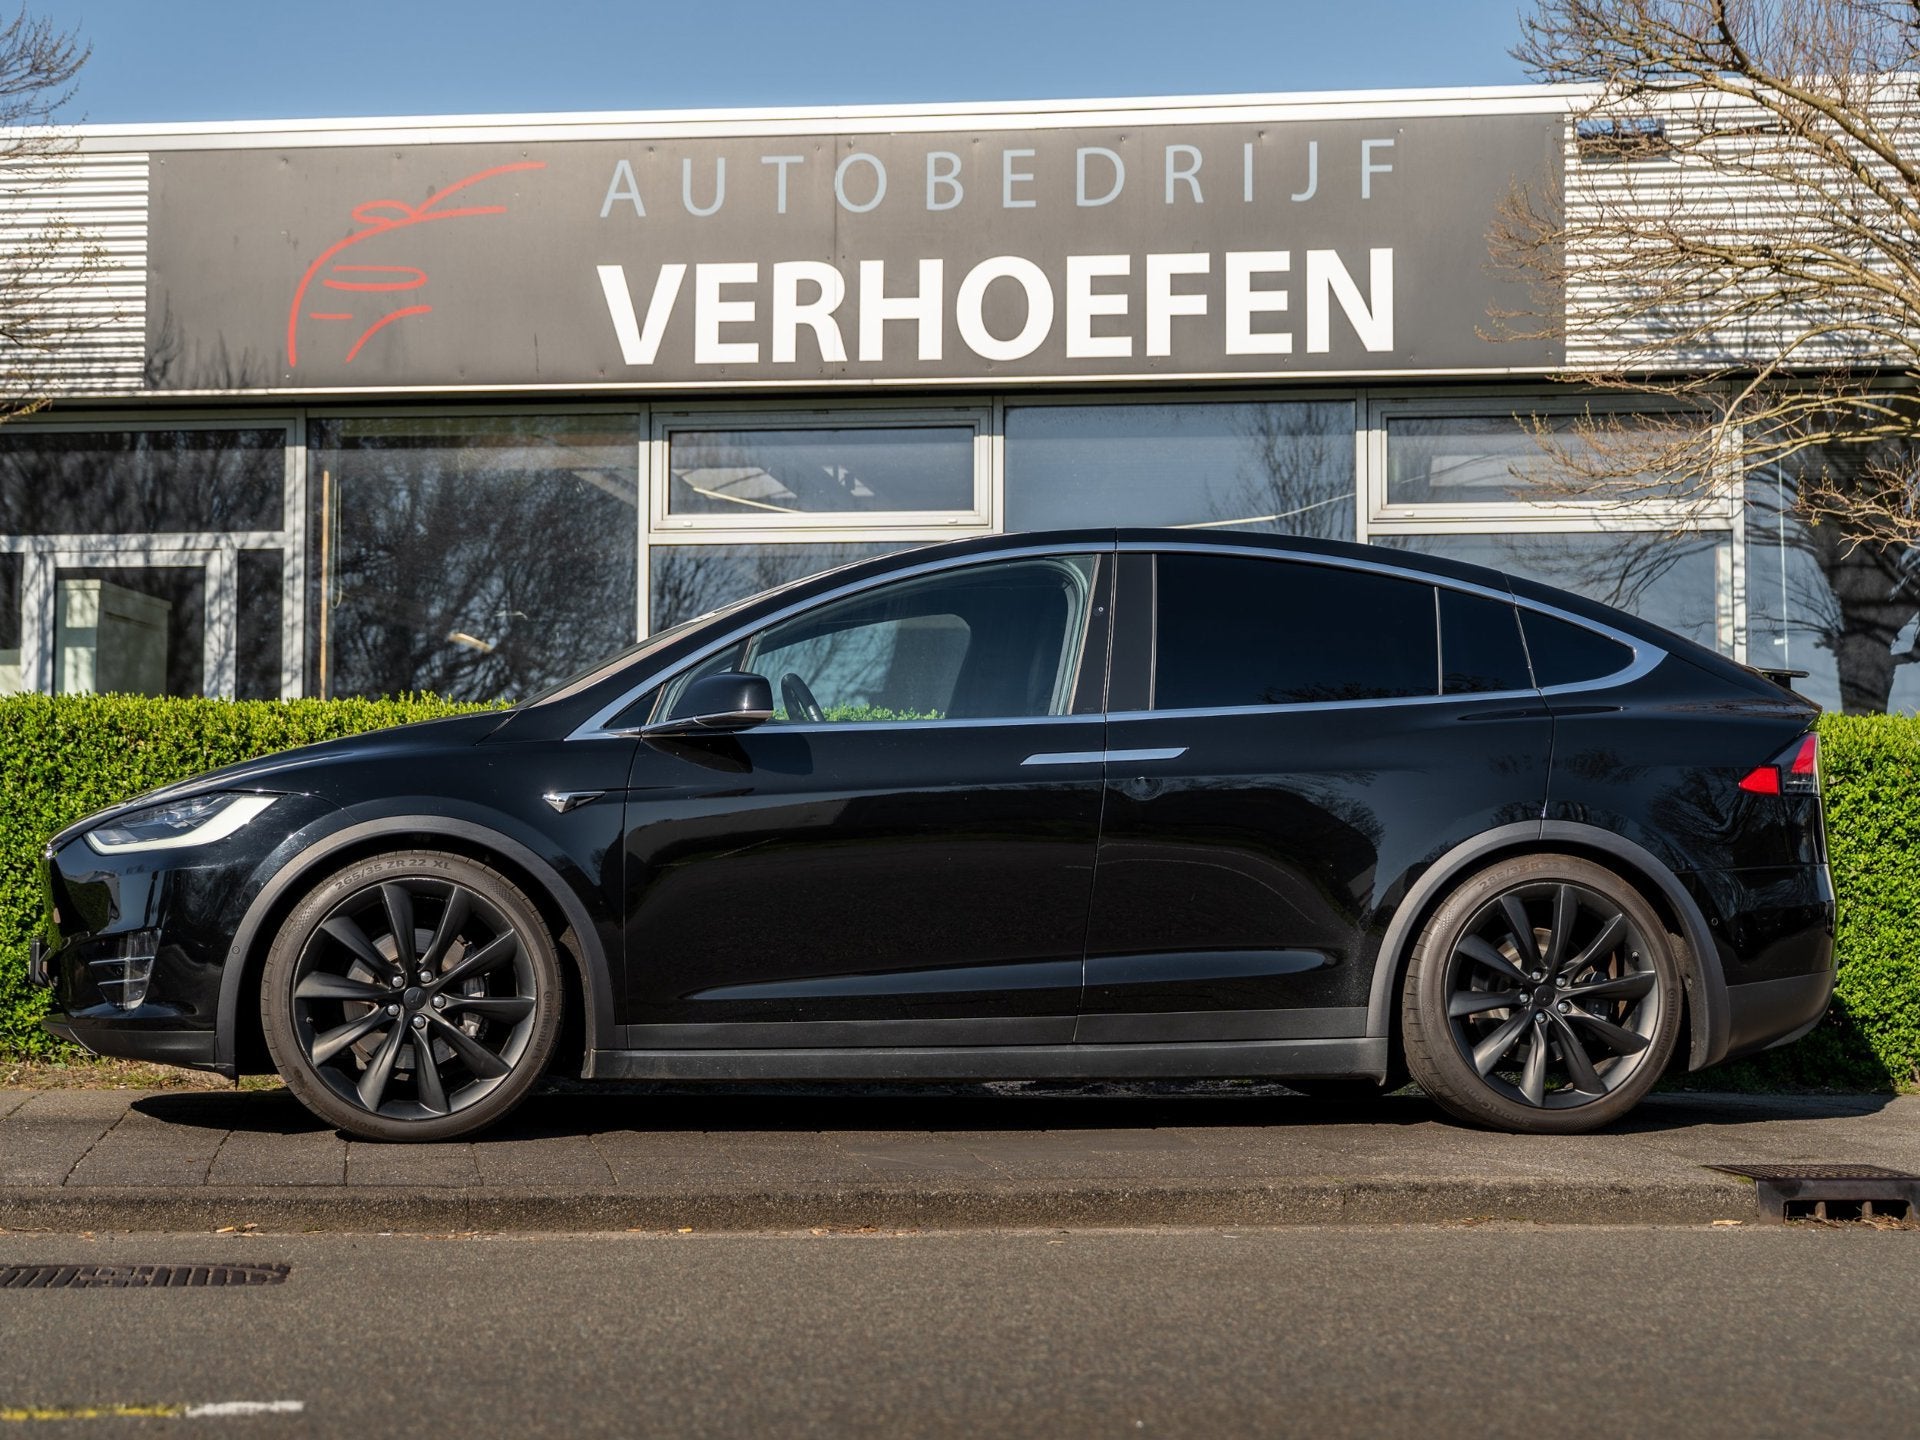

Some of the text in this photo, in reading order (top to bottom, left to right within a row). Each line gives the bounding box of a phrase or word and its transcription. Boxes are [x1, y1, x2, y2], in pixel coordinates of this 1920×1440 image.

[600, 139, 1395, 218] AUTOBEDRIJF
[596, 247, 1394, 366] VERHOEFEN
[335, 863, 383, 890] 265/35
[386, 859, 405, 869] ZR
[408, 858, 426, 867] 22
[432, 859, 452, 870] XL
[534, 990, 554, 1053] Continental
